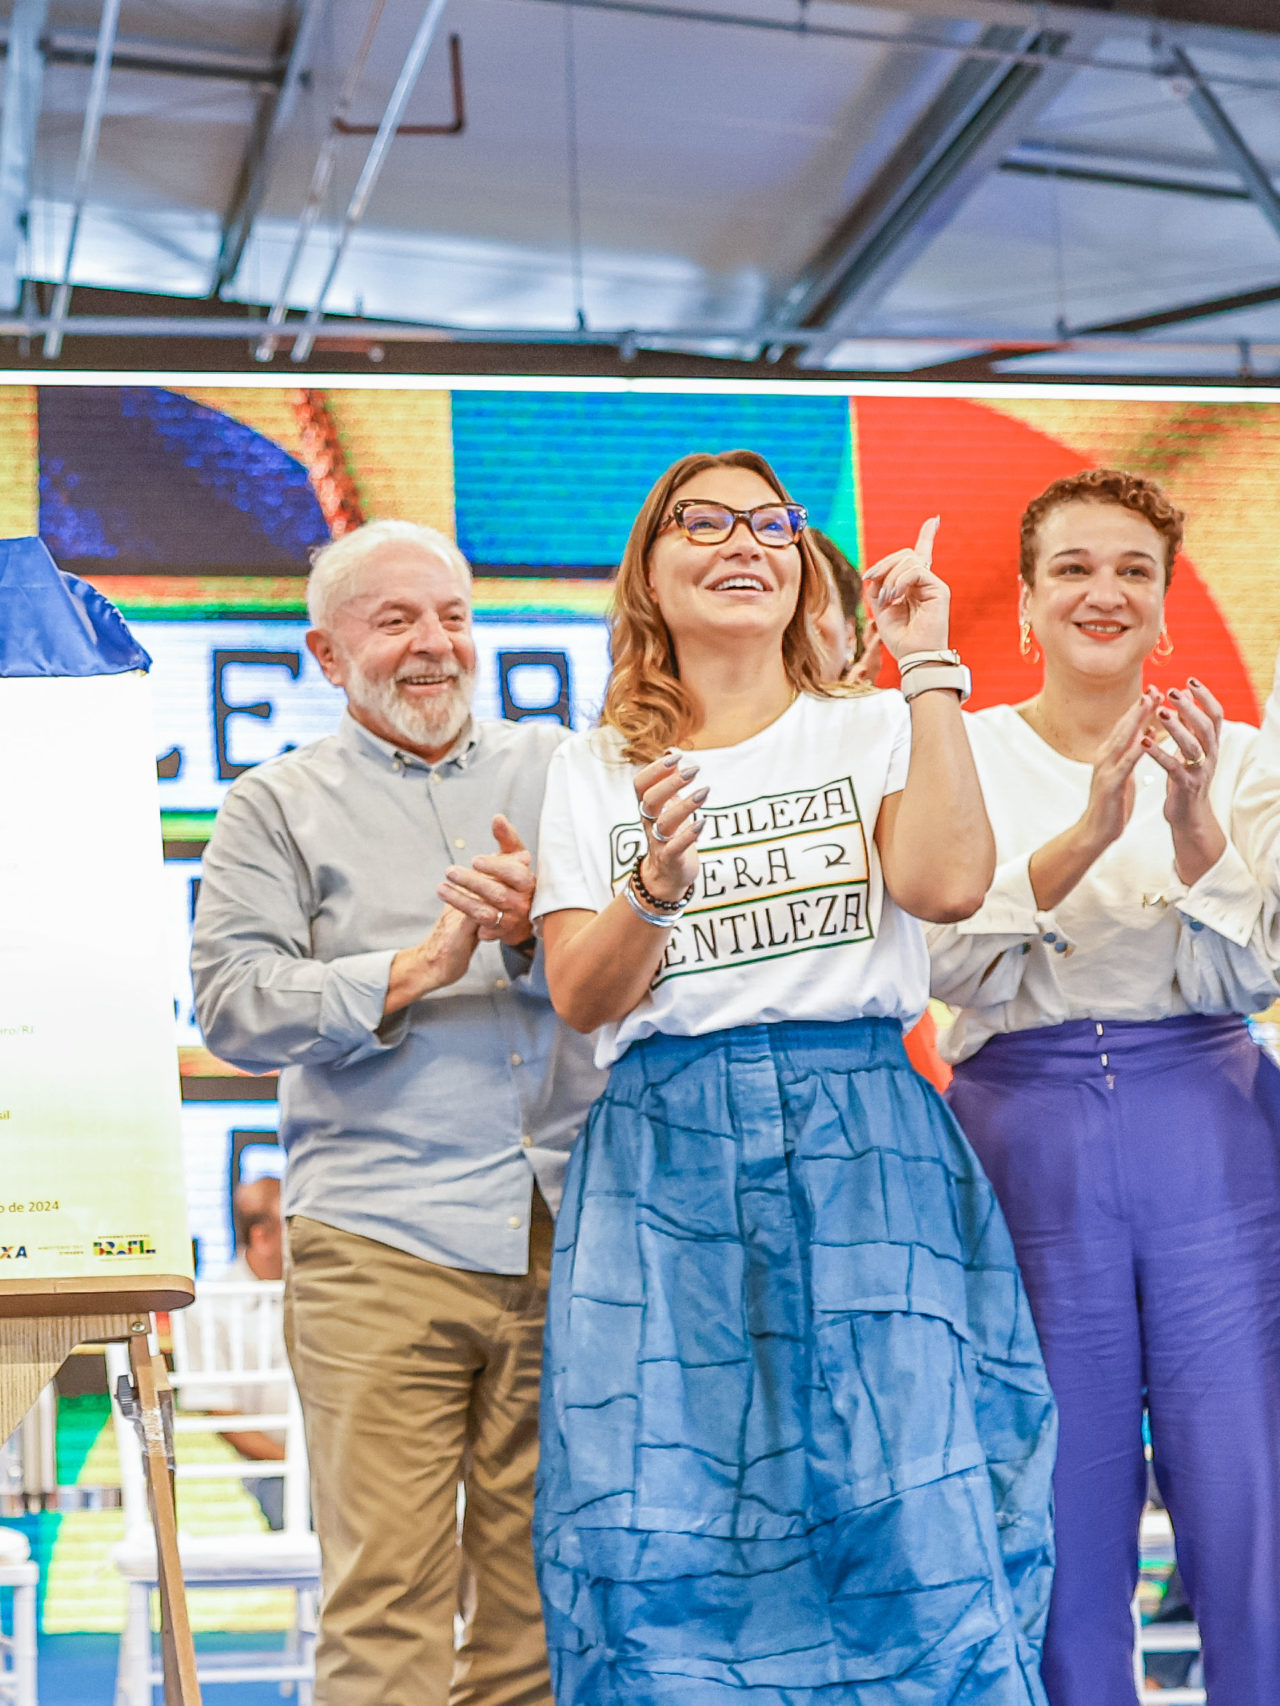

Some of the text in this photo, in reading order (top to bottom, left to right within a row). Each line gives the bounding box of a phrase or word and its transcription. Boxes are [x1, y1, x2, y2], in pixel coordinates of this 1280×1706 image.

[616, 787, 851, 865] GTILEZA
[701, 847, 796, 898] ERA
[656, 893, 864, 976] ENTILEZA
[8, 1202, 25, 1214] de
[28, 1201, 60, 1213] 2024
